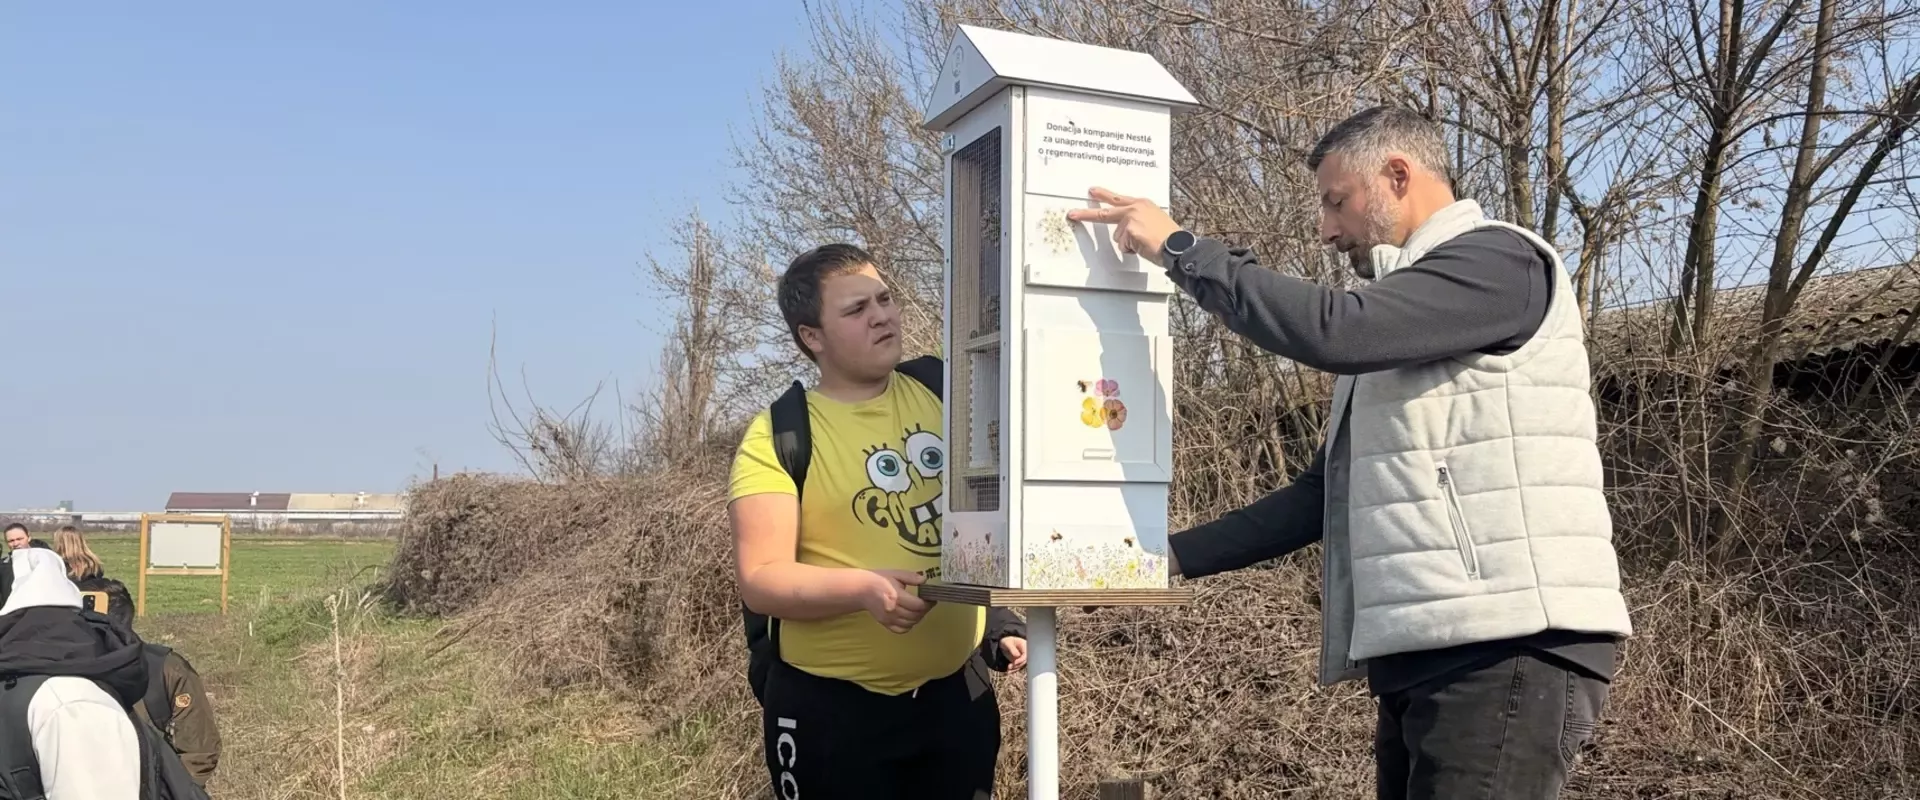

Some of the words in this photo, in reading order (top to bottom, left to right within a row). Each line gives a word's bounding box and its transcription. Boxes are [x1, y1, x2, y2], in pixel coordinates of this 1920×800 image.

[1046, 122, 1082, 135] Donacija
[1083, 127, 1124, 140] kompanije
[1126, 132, 1152, 143] Nestlé
[1055, 137, 1105, 150] unapređenje
[1106, 143, 1155, 157] obrazovanja
[1046, 148, 1105, 163] regenerativnoj
[1106, 155, 1158, 168] poljoprivredi.
